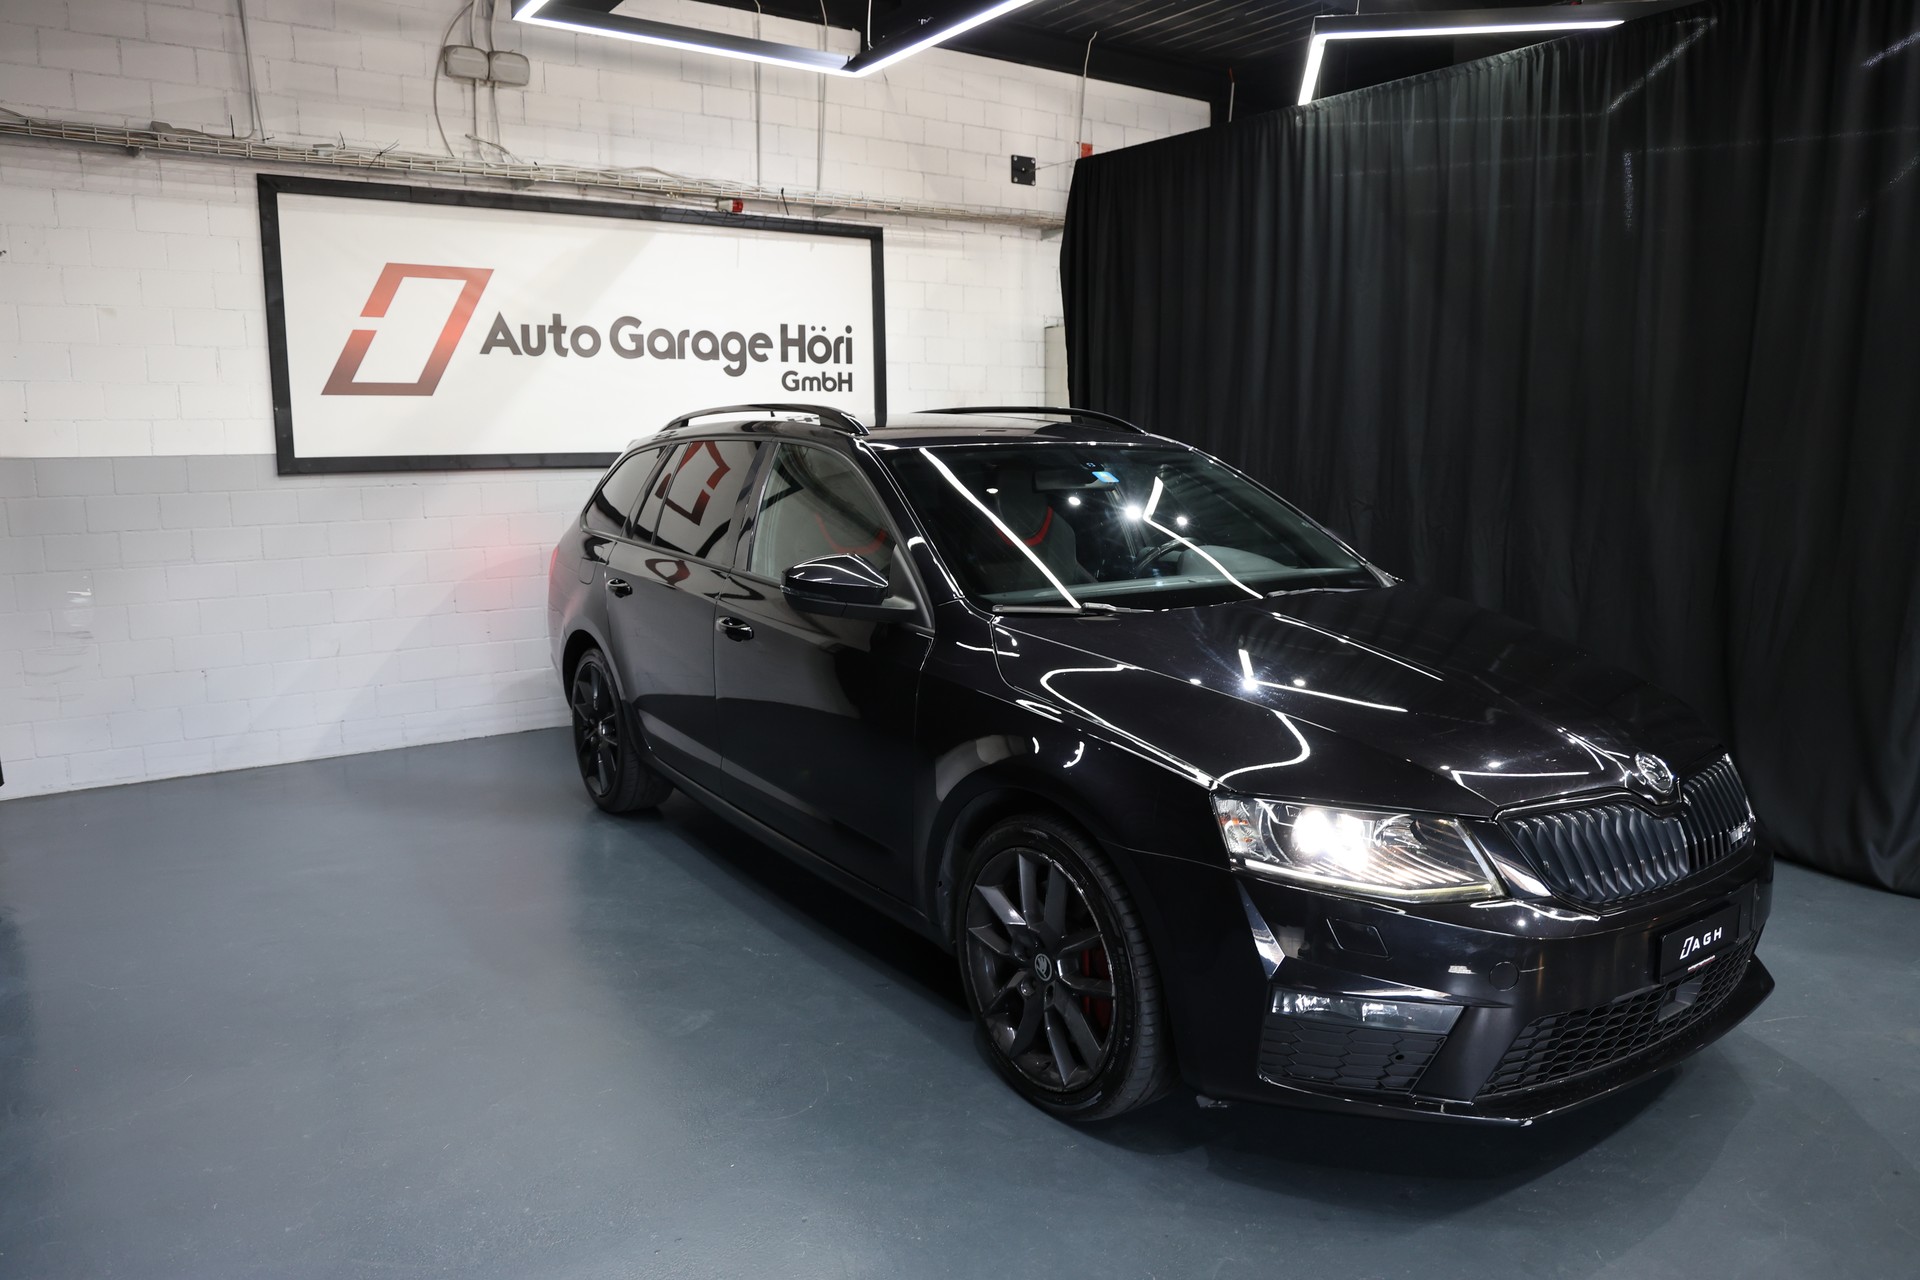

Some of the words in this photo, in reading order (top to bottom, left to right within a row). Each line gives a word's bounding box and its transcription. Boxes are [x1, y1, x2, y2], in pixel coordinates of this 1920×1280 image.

[479, 311, 602, 358] Auto
[609, 315, 774, 378] Garage
[780, 323, 853, 365] Höri
[781, 370, 853, 392] GmbH
[1692, 926, 1722, 952] AGH
